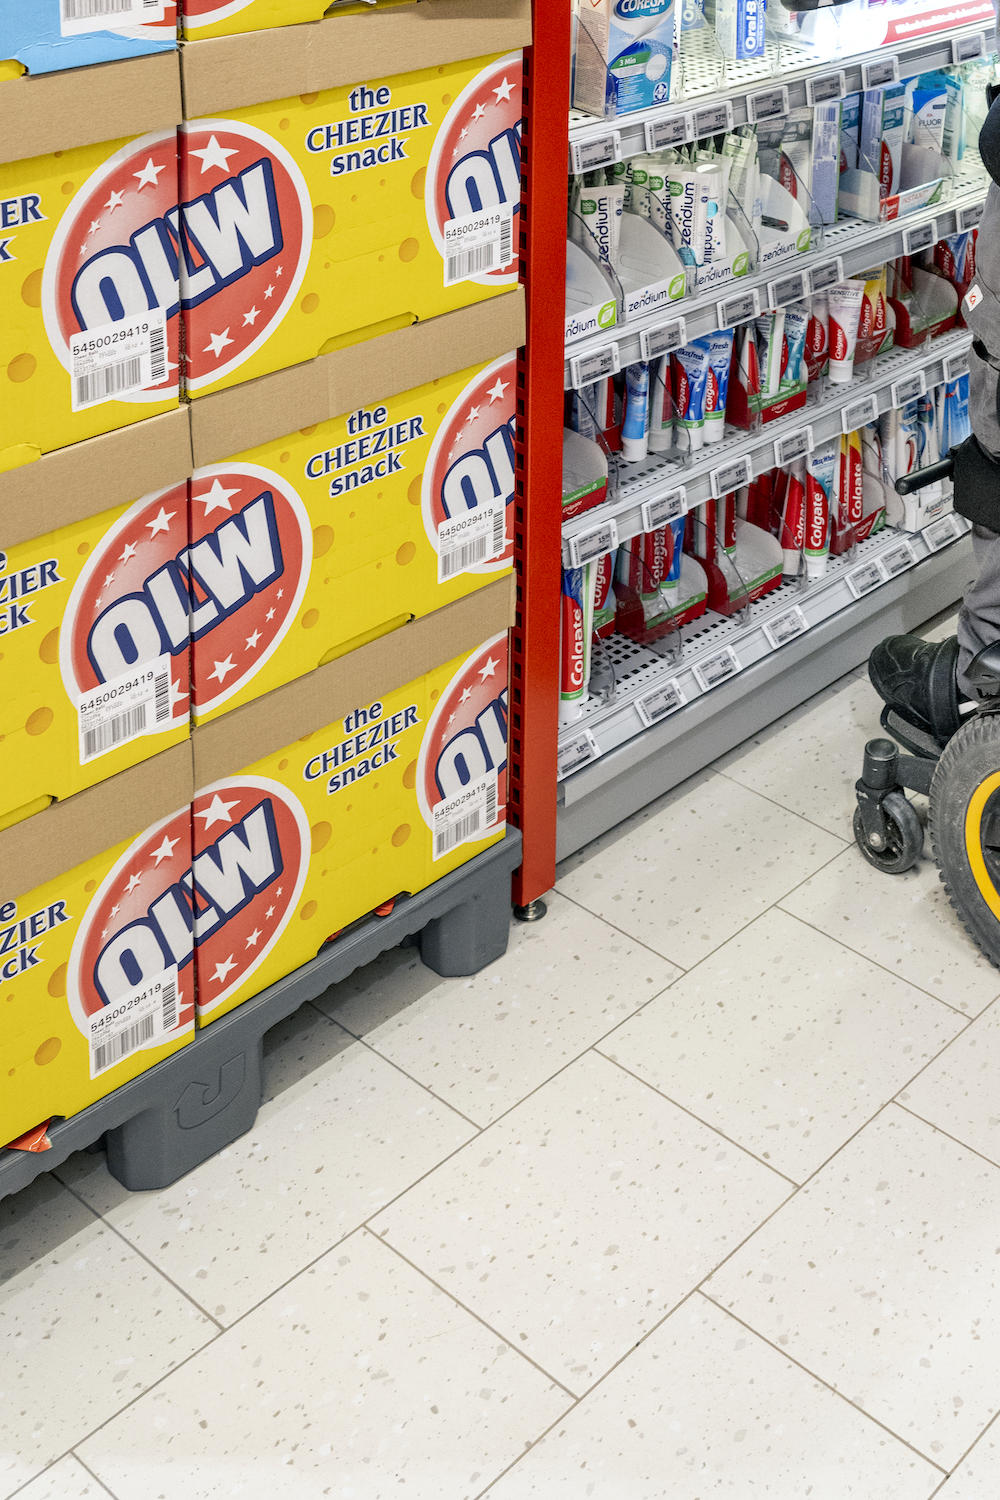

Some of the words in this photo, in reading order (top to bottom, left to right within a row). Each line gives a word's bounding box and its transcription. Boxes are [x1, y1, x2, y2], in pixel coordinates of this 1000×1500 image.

[744, 0, 757, 51] Oral-B
[348, 86, 391, 113] the
[306, 103, 430, 153] CHEEZIER
[331, 139, 408, 176] snack
[446, 124, 522, 220] OL
[445, 214, 501, 240] 5450029419
[597, 196, 610, 263] zendium
[680, 182, 694, 246] zendium
[72, 159, 283, 330] OLW
[763, 242, 795, 262] zendium
[628, 289, 667, 313] zendium
[73, 323, 149, 356] 5450029419
[566, 319, 596, 338] ndium
[834, 328, 842, 360] Colgate
[706, 372, 714, 411] Colgate
[347, 406, 387, 434] the
[305, 415, 425, 478] CHEEZIER
[441, 418, 515, 516] OL
[329, 450, 404, 498] snack
[852, 463, 862, 519] Colgate
[440, 508, 493, 539] 5450029419
[811, 492, 823, 548] Colgate
[88, 492, 283, 682] OLW
[570, 608, 583, 686] Colgate
[80, 671, 154, 714] 5450029419
[343, 700, 383, 733] the
[304, 705, 419, 781] CHEEZIER
[327, 740, 399, 793] snack
[435, 689, 507, 801] OL
[434, 782, 487, 820] 5450029419
[95, 799, 283, 1004] OLW
[90, 983, 162, 1032] 5450029419
